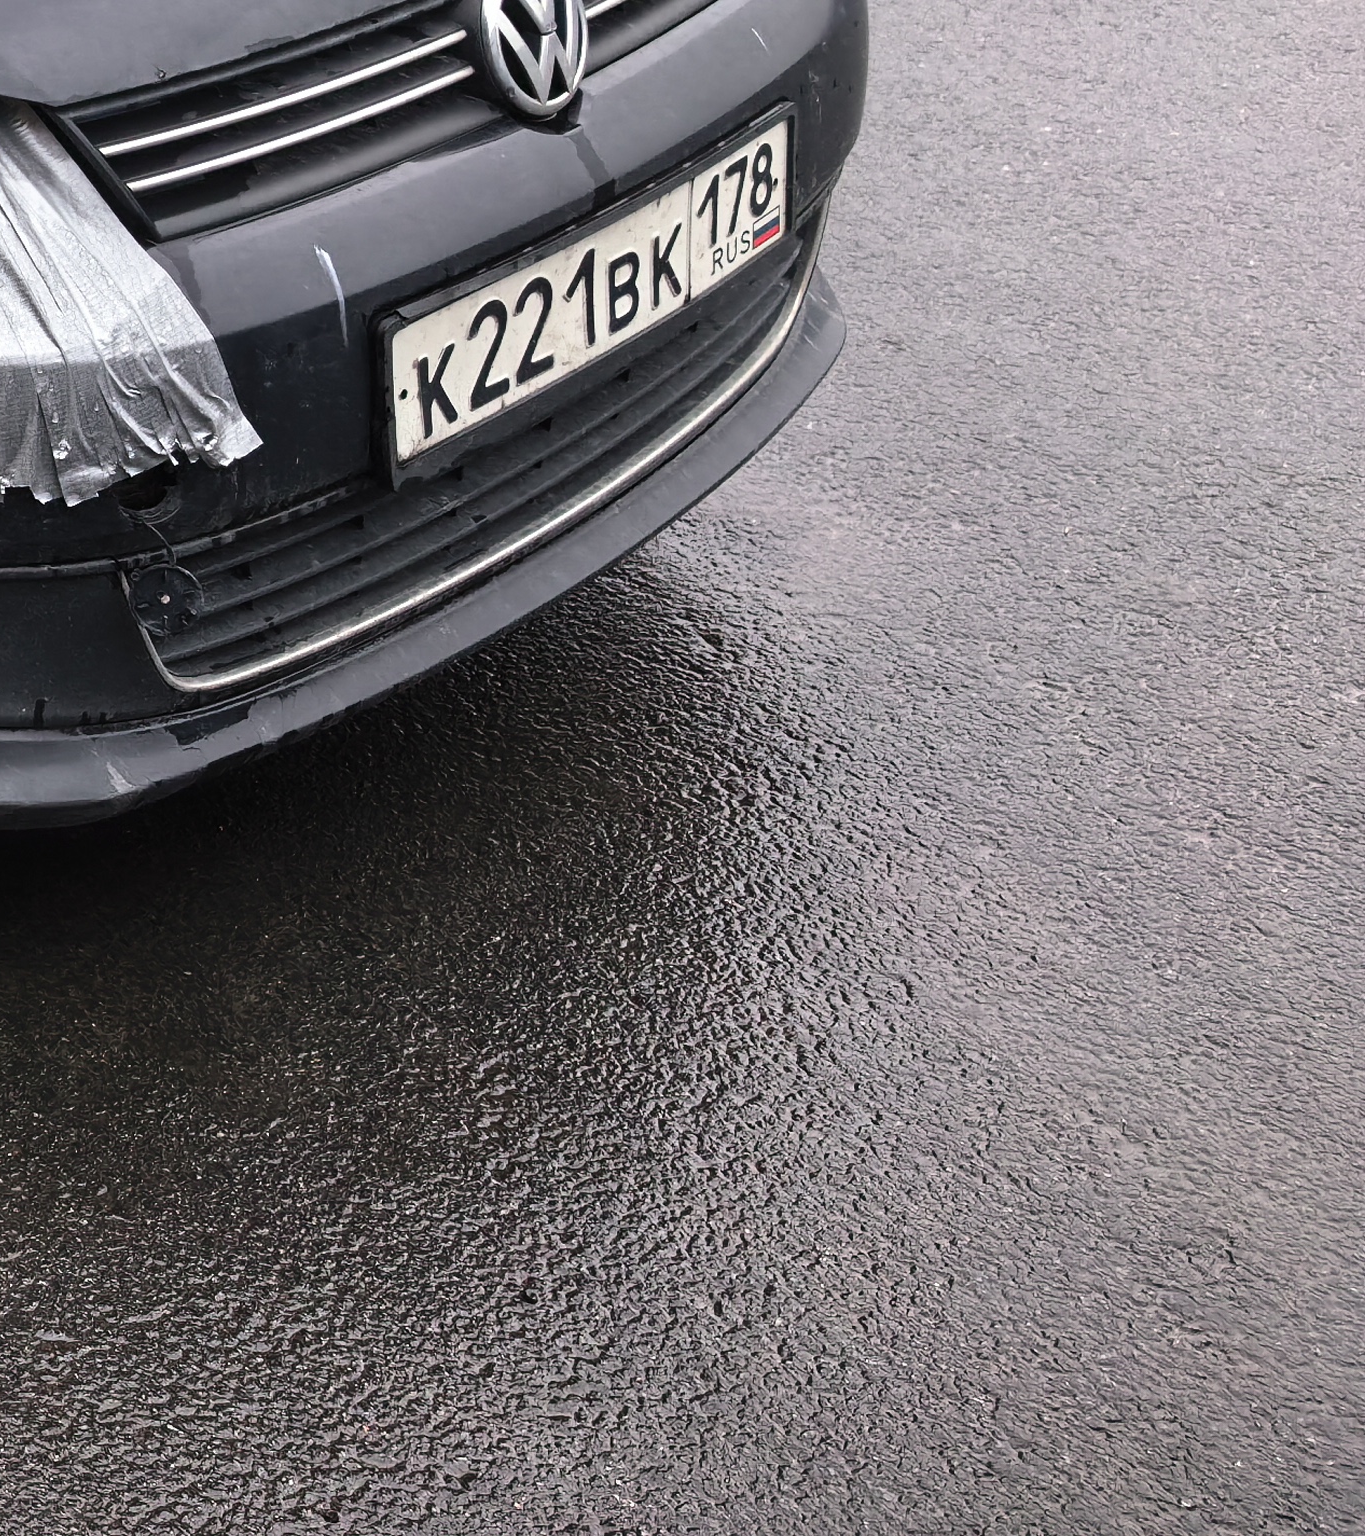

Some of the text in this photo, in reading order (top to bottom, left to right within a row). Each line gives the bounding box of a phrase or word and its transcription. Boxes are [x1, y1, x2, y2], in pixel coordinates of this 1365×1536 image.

[416, 142, 775, 439] К221ВК 178
[711, 229, 751, 275] RUS
